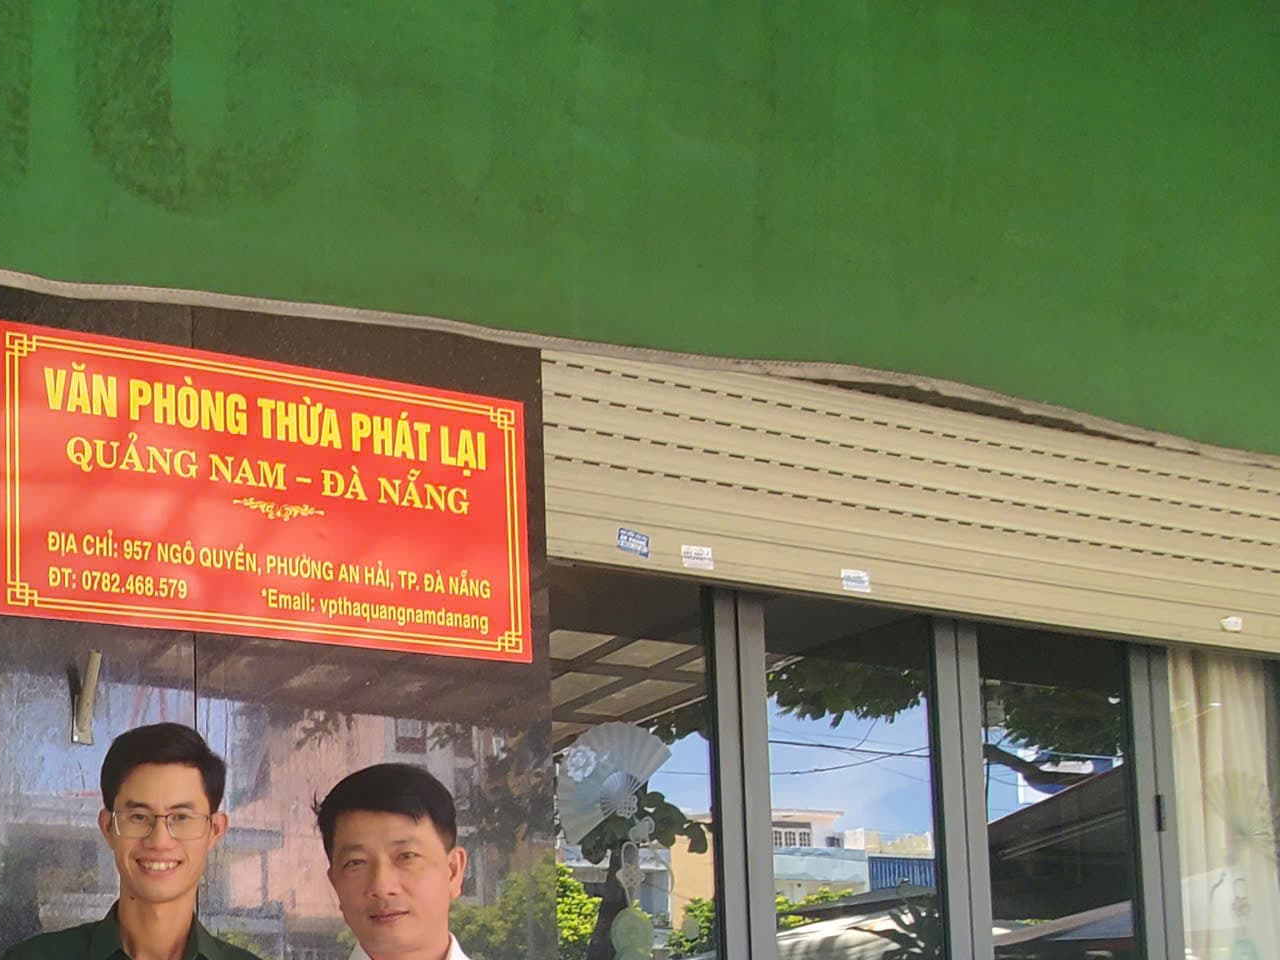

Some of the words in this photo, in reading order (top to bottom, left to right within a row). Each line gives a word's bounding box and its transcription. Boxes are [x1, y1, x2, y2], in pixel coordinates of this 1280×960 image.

[43, 361, 118, 418] VĂN
[128, 375, 248, 436] PHÒNG
[257, 395, 342, 449] THỪA
[351, 411, 431, 462] PHÁT
[439, 425, 487, 477] LẠI
[65, 431, 199, 479] QUẢNG
[208, 453, 287, 490] NAM
[320, 465, 368, 501] ĐÀ
[377, 468, 470, 515] NẴNG
[47, 530, 78, 557] ĐỊA
[81, 529, 118, 559] CHỈ:
[123, 539, 152, 561] 957
[157, 540, 195, 566] NGÔ
[266, 553, 334, 581] PHƯỜNG
[338, 563, 360, 584] AN
[364, 560, 395, 590] HẢI,
[398, 569, 420, 592] TP.
[423, 568, 445, 594] ĐÀ
[48, 566, 77, 589] ĐT:
[81, 570, 188, 600] 0782.468.579
[319, 596, 489, 635] vpthaquangnamdanang
